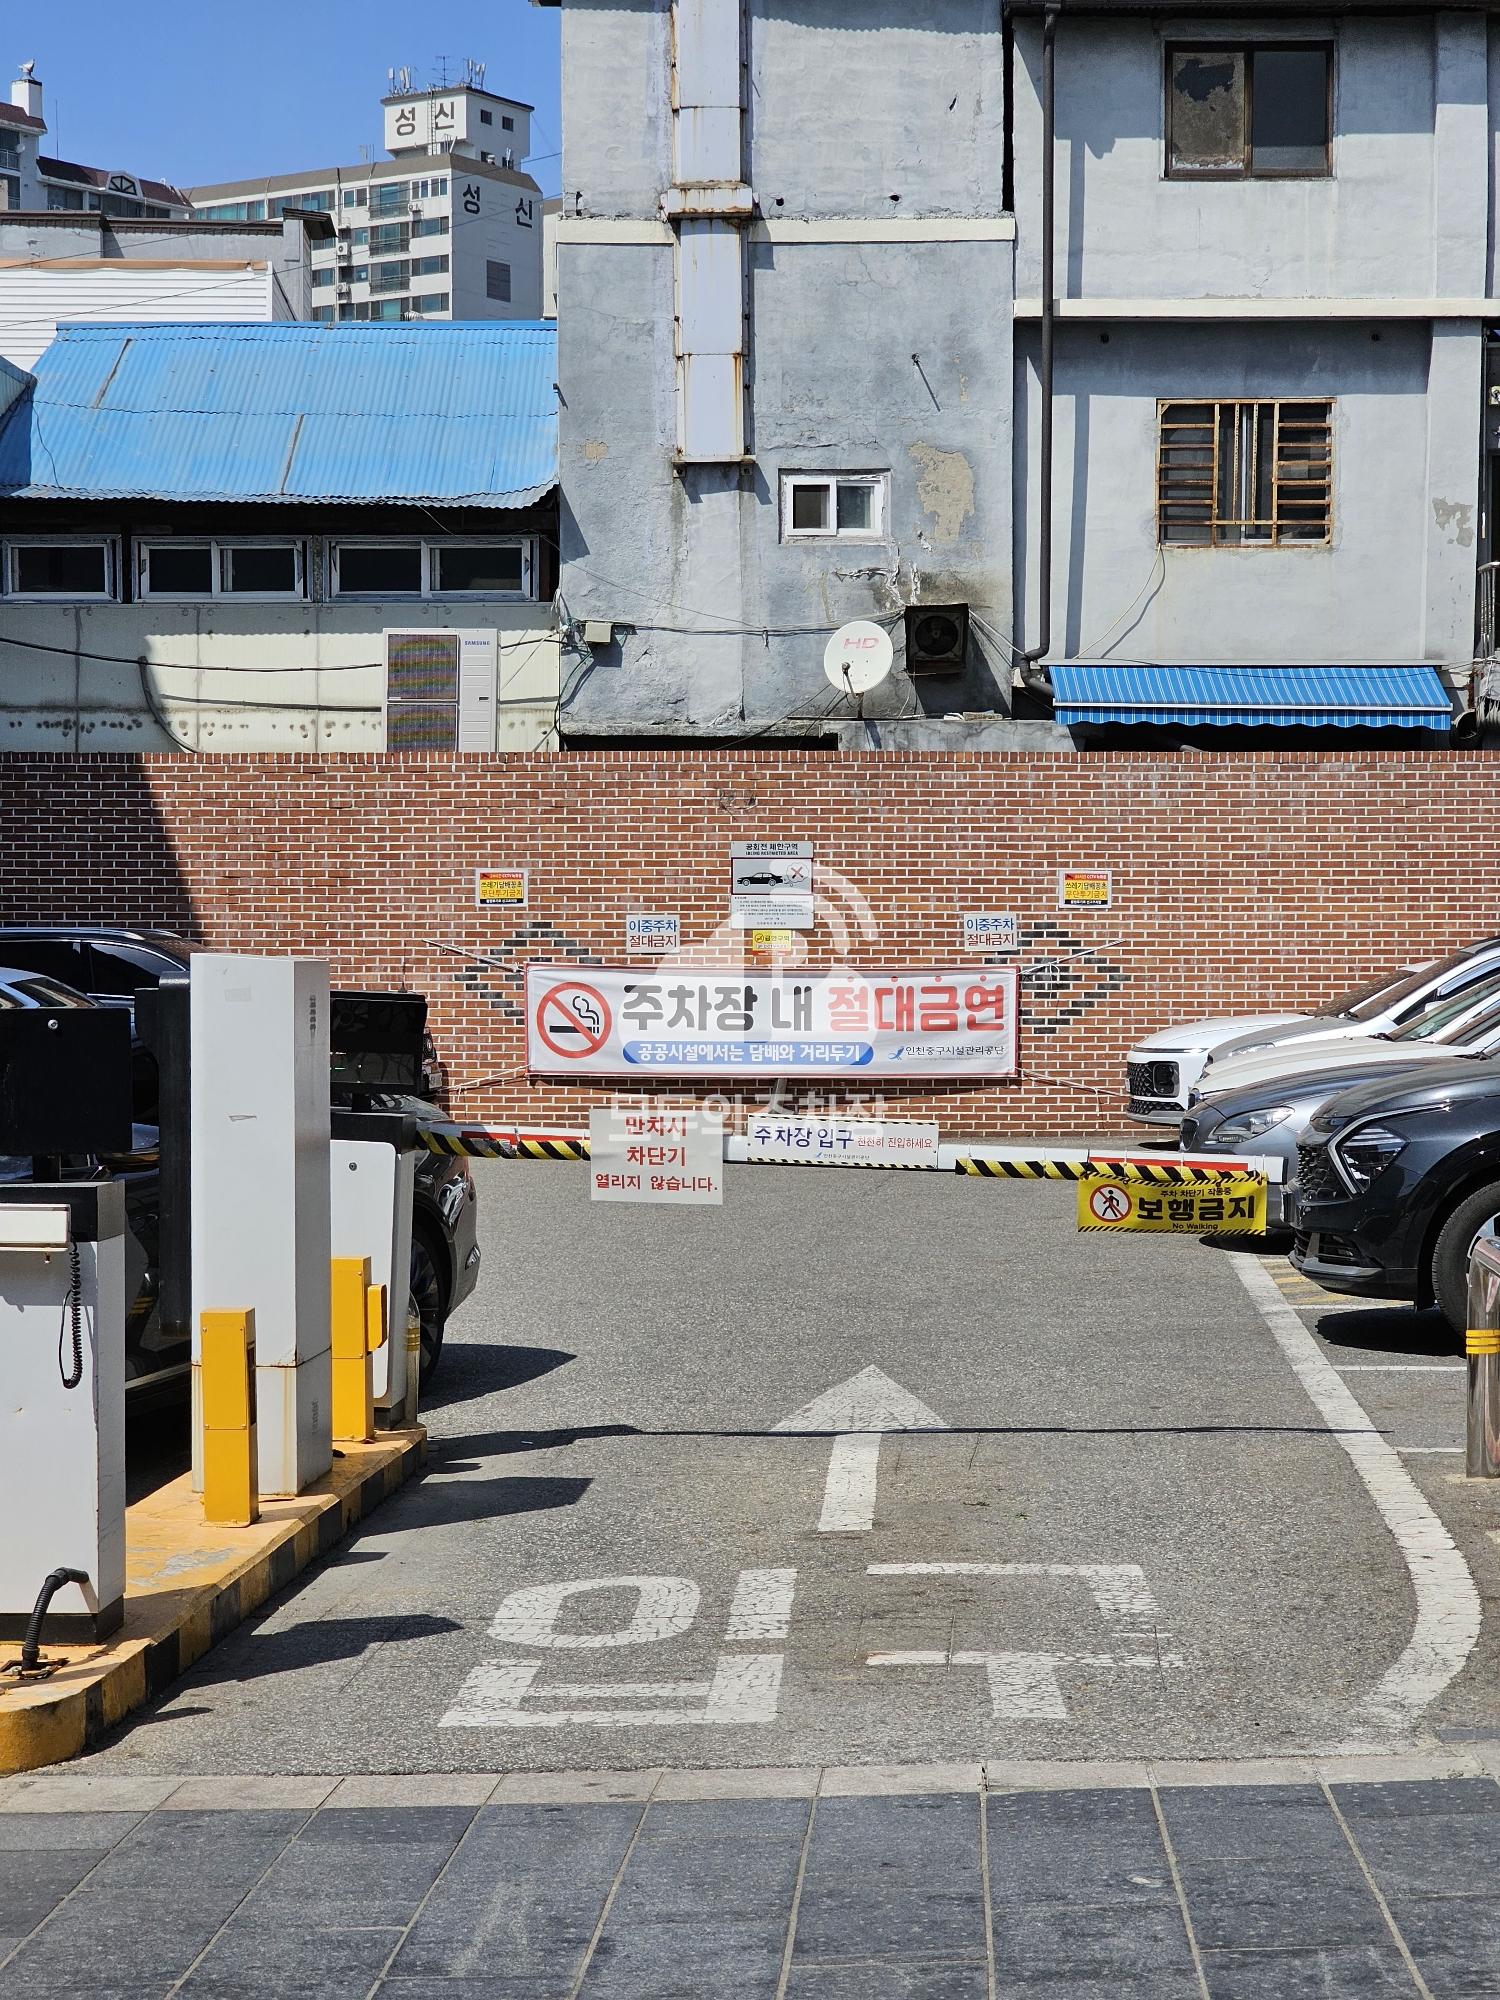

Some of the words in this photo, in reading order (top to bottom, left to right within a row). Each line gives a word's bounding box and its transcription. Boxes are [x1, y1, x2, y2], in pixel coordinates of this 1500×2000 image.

[843, 637, 880, 649] HD
[481, 890, 523, 898] 무단투기금지
[1065, 890, 1107, 898] 무단투기금지
[629, 919, 678, 933] 이중주차
[966, 917, 1015, 931] 이중주차
[630, 934, 677, 948] 절대금지
[967, 932, 1015, 946] 절대금지
[622, 984, 758, 1032] 주차장
[771, 984, 813, 1032] 내
[828, 984, 1005, 1032] 절대금연
[638, 1043, 745, 1061] 공공시설에서는
[750, 1044, 796, 1062] 담배와
[800, 1044, 860, 1062] 거리두기
[905, 1045, 1005, 1056] 인천중구시설관리공단
[625, 1116, 687, 1137] 만차시
[754, 1125, 813, 1148] 주차장
[817, 1128, 855, 1150] 입구
[857, 1136, 884, 1148] 천천히
[888, 1136, 933, 1150] 진입하세요
[627, 1146, 686, 1167] 차단기
[595, 1173, 641, 1190] 열리지
[650, 1175, 718, 1192] 않습니다.
[1160, 1190, 1178, 1198] 주차
[1180, 1188, 1205, 1198] 차단기
[1137, 1196, 1255, 1221] 보행금지
